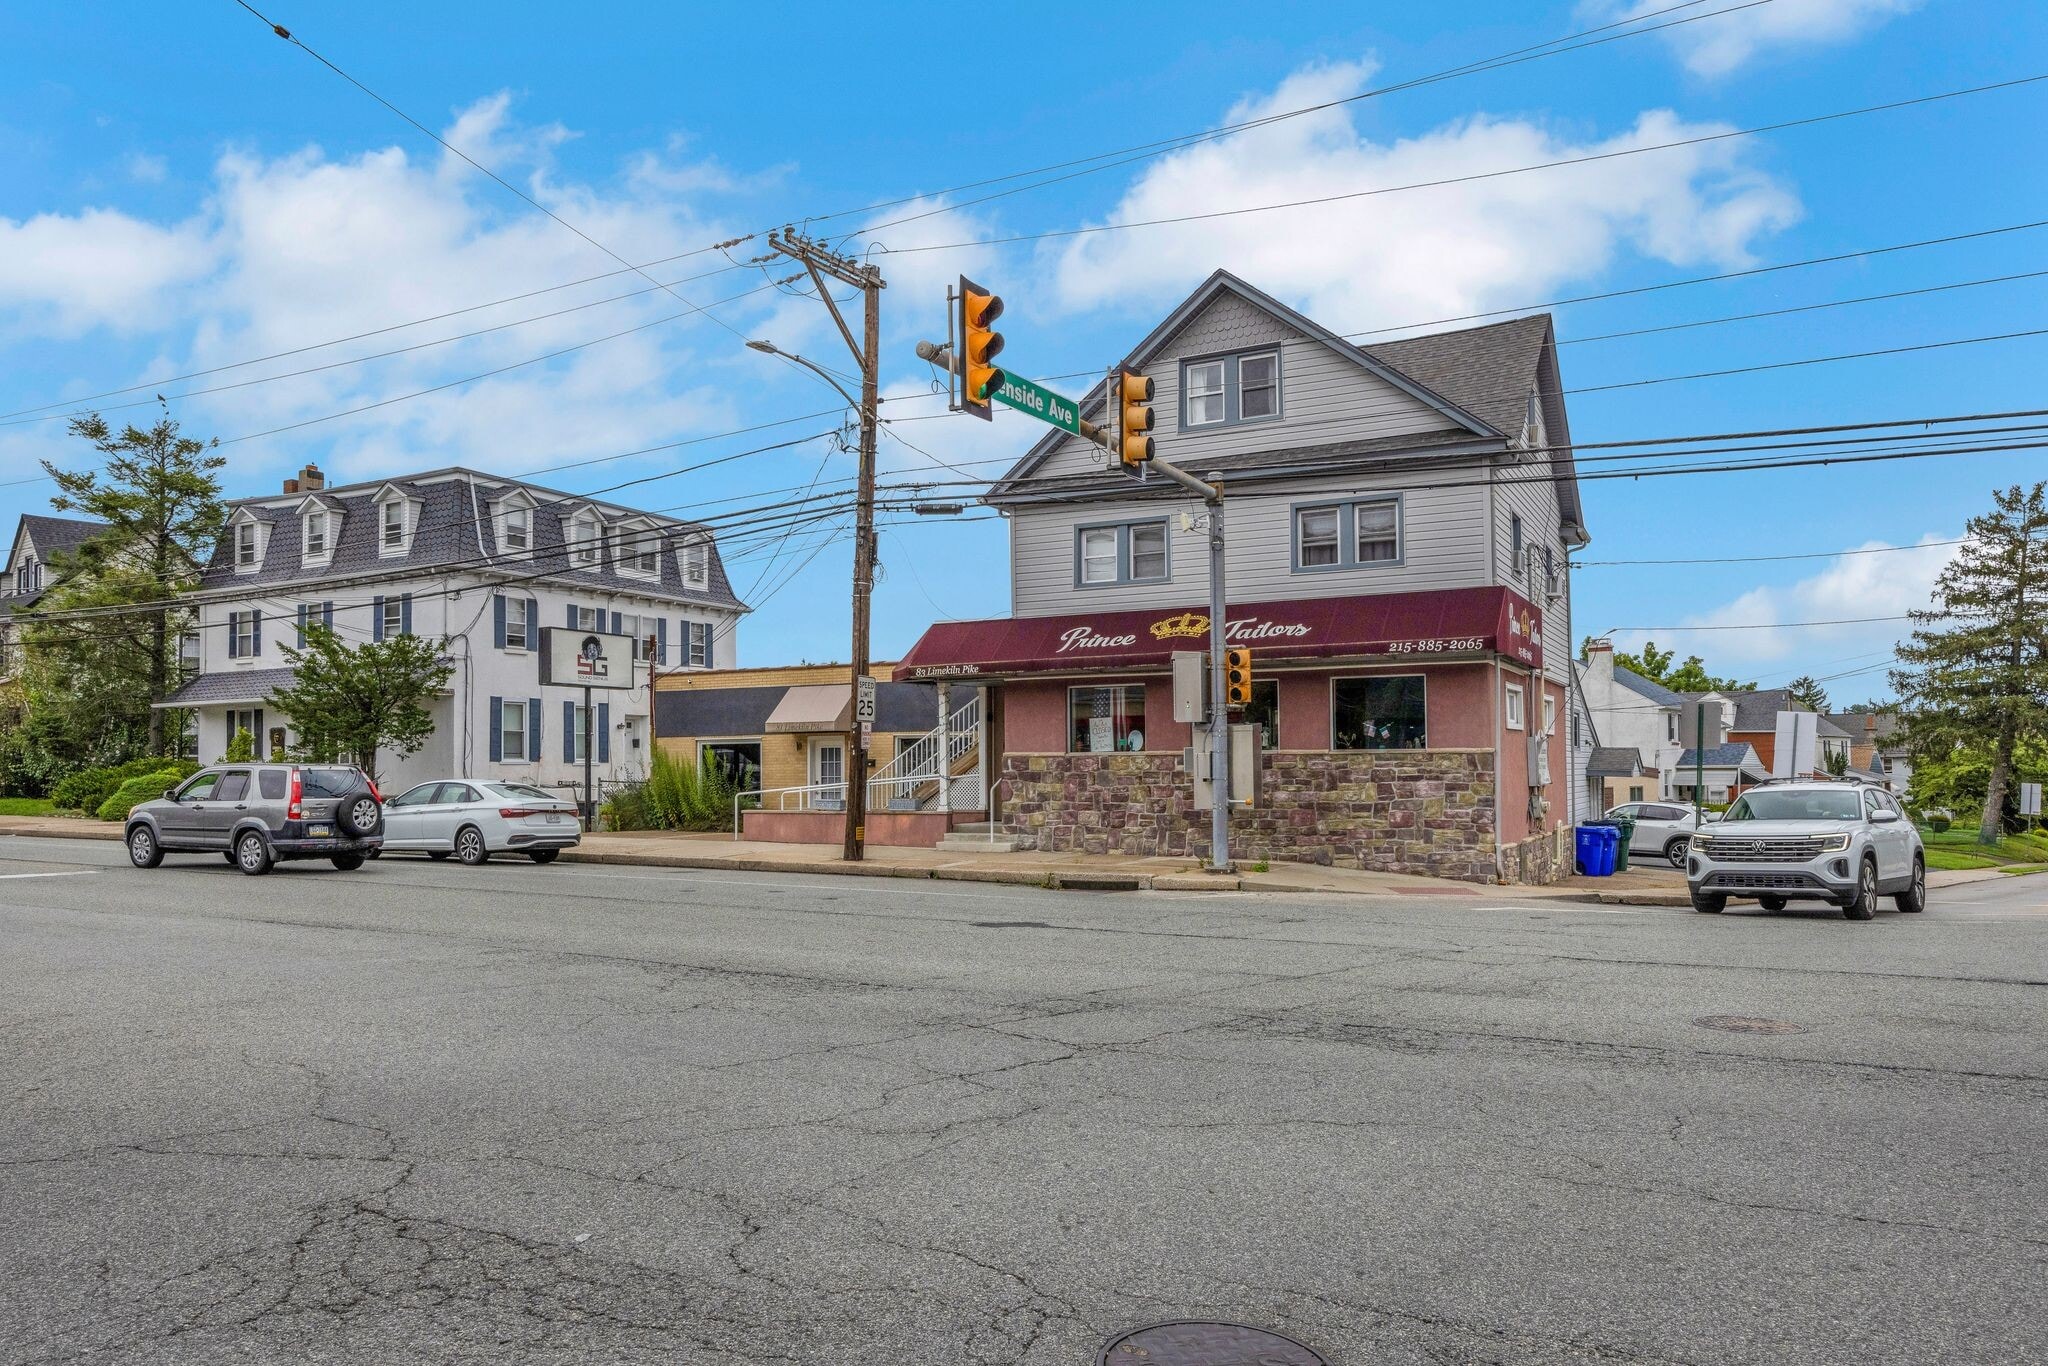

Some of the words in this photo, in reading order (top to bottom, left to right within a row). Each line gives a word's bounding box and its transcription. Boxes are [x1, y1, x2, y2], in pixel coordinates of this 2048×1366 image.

[999, 382, 1044, 412] enside
[1048, 398, 1073, 424] Ave
[1056, 626, 1137, 653] Prince
[1224, 617, 1312, 640] Tailors
[1388, 638, 1484, 653] 215-885-2065
[915, 667, 926, 677] 83
[927, 665, 961, 676] Limekiln
[962, 664, 979, 674] Pike
[859, 681, 875, 689] SPEED
[860, 690, 872, 698] LIMIT
[858, 700, 874, 716] 25
